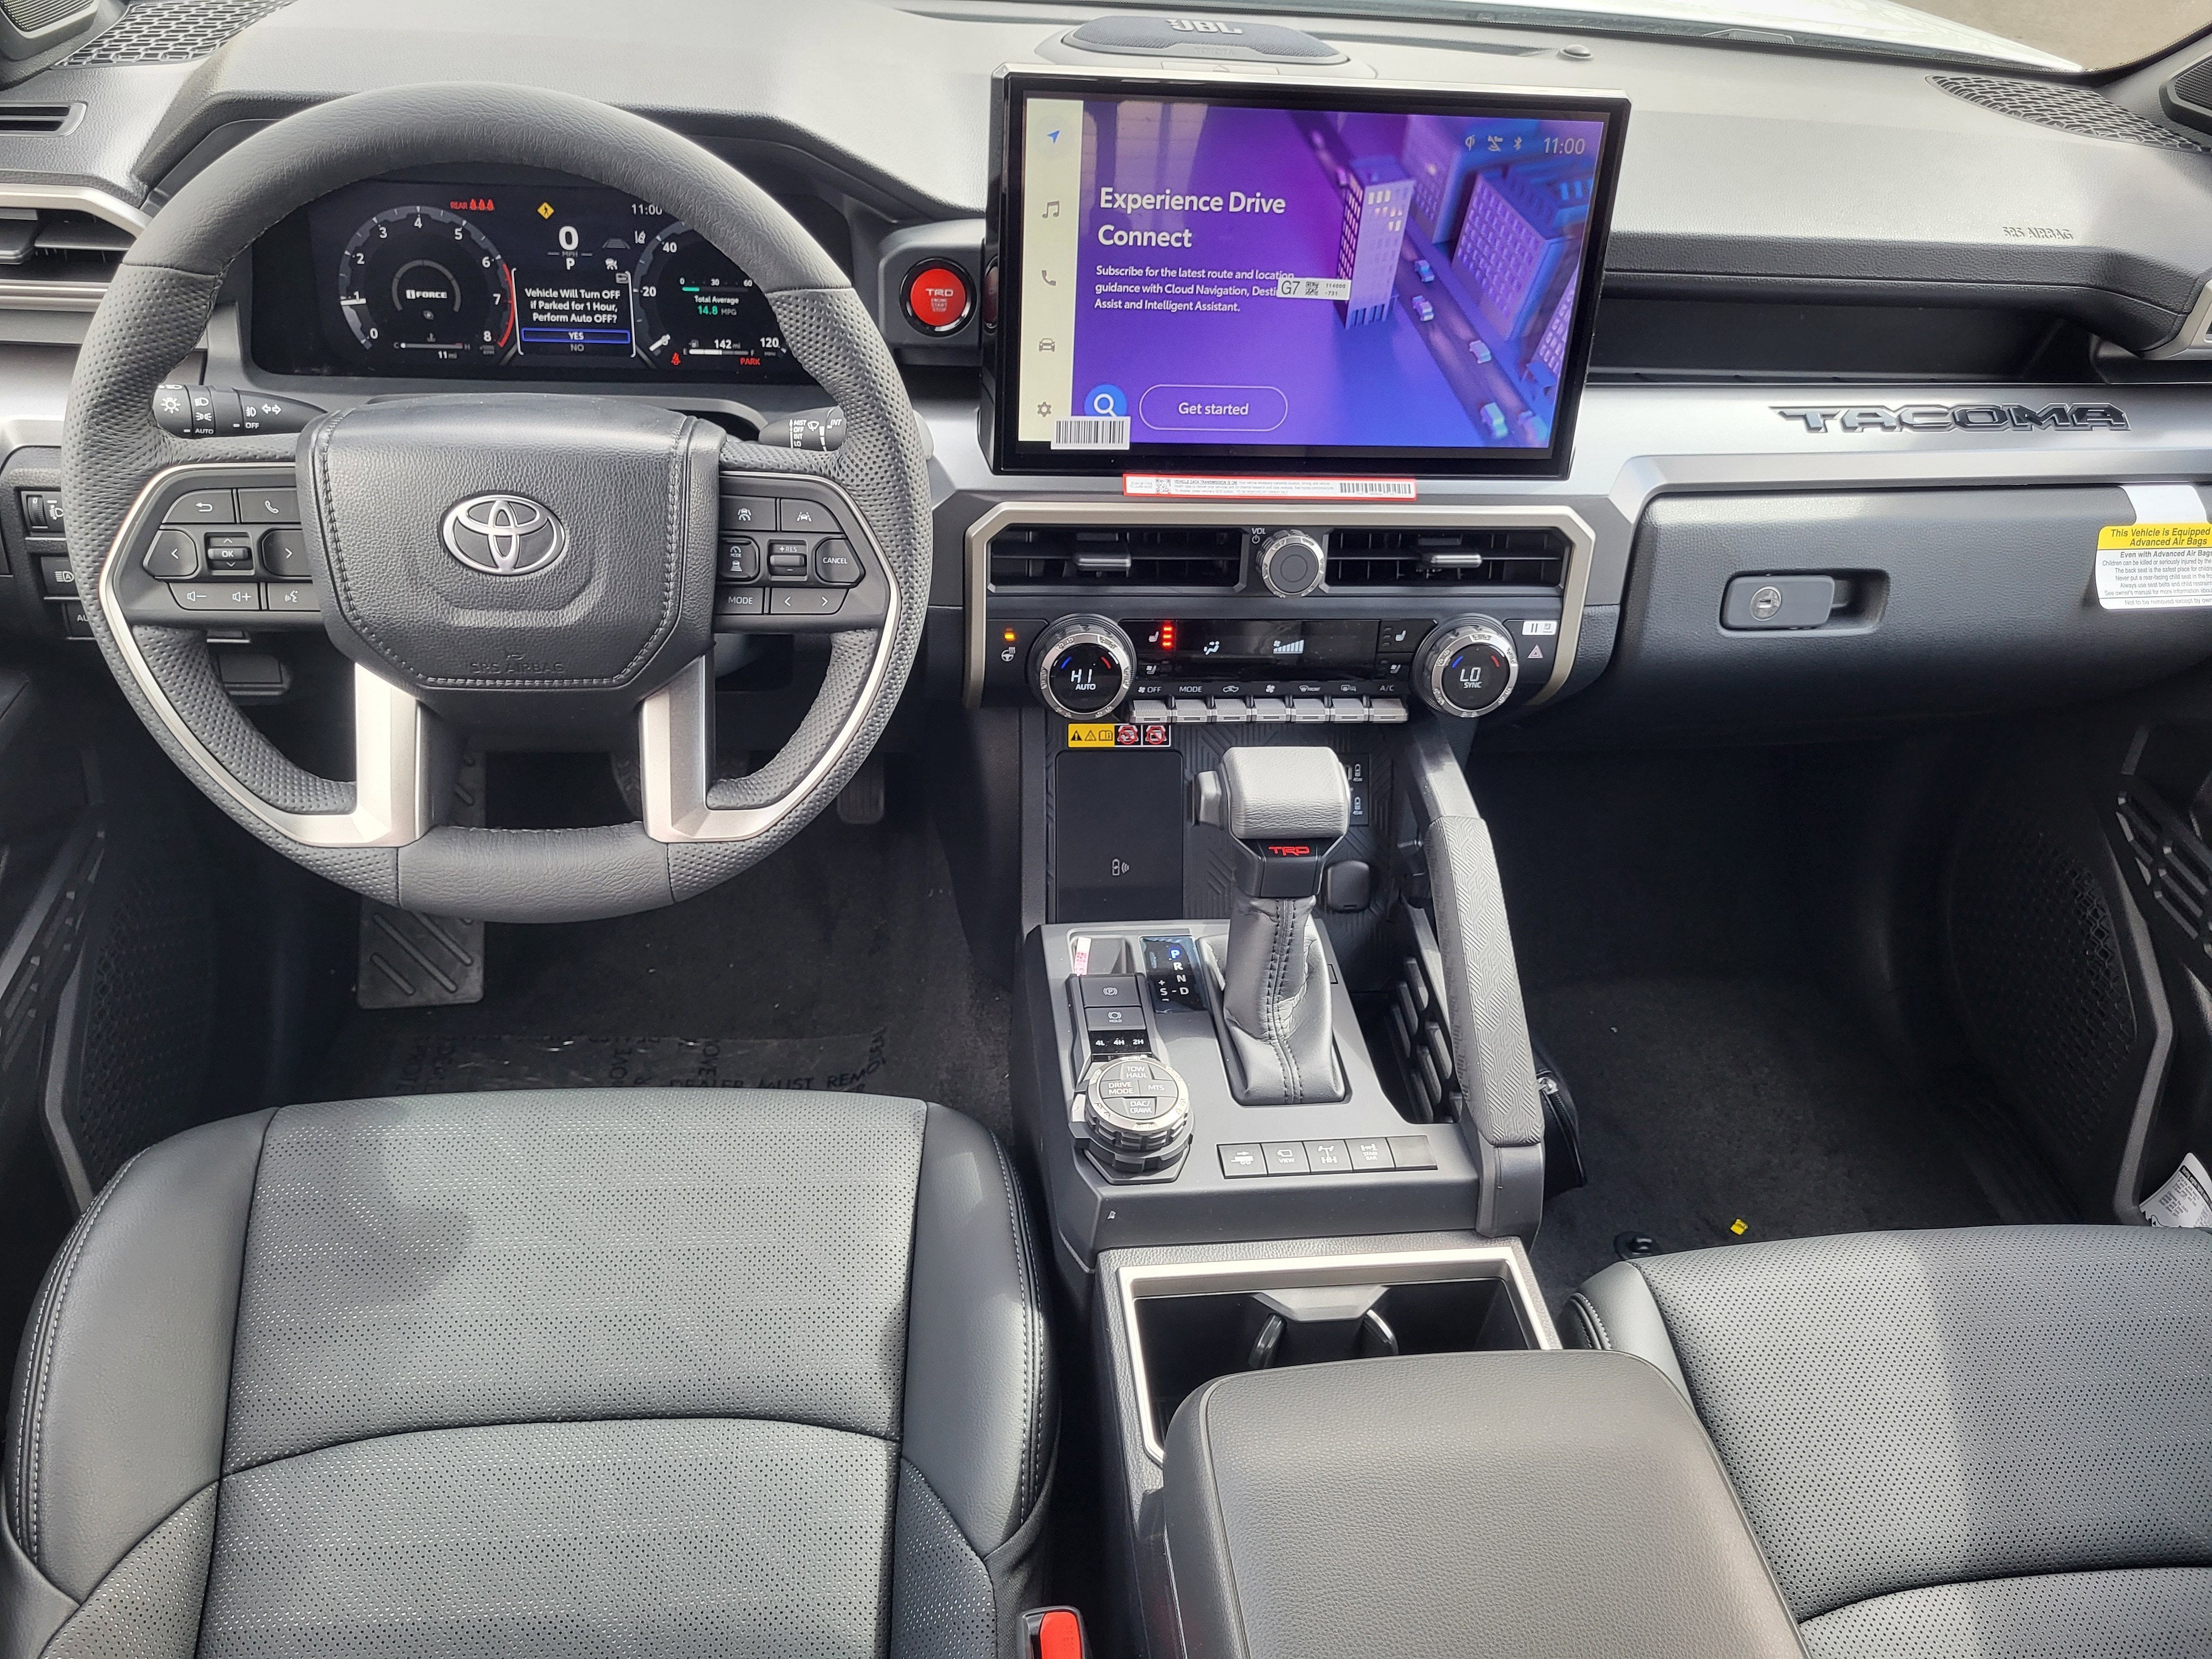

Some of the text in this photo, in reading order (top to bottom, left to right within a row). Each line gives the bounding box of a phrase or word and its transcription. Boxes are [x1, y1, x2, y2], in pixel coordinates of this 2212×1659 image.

[1168, 19, 1243, 35] JBL
[1543, 137, 1585, 155] 11:00
[1099, 187, 1286, 214] Experience Drive
[632, 204, 662, 215] 11:00
[414, 217, 422, 228] 4
[379, 227, 388, 238] 3
[455, 229, 462, 240] 5
[1098, 224, 1193, 248] Connect
[2002, 227, 2073, 239] SRS AIRBAG
[559, 226, 579, 251] 0
[663, 242, 677, 253] 40
[357, 253, 365, 264] 2
[482, 257, 491, 268] 6
[566, 258, 575, 270] P
[1096, 265, 1294, 280] Subscribe for the latest route and location
[642, 286, 656, 297] 20
[926, 288, 954, 297] TRD
[1095, 283, 1277, 297] guidance with Cloud Navigation, Desti
[1281, 280, 1300, 295] G7
[524, 288, 620, 299] Vehicle Will Turn OFF
[493, 294, 501, 305] 7
[712, 295, 739, 305] Average
[530, 300, 618, 312] If Parked for 1 Hour,
[697, 305, 718, 315] 14.8
[1094, 299, 1240, 312] Assist and Intelligent Assistant.
[533, 312, 617, 323] Perform Auto OFF?
[369, 328, 378, 339] 0
[483, 331, 492, 342] 8
[568, 332, 584, 340] YES
[714, 340, 732, 349] 142
[760, 337, 779, 347] 120
[438, 351, 447, 359] 11
[1178, 402, 1249, 415] Get started
[1768, 403, 2131, 432] TACOMA
[2131, 528, 2160, 536] Vehicle
[2162, 528, 2169, 536] is
[2172, 528, 2210, 539] Equipped
[2130, 538, 2171, 546] Advanced
[2187, 537, 2207, 546] Bags
[728, 596, 753, 604] MODE
[472, 663, 565, 674] SRS AIRBAG
[1071, 669, 1093, 684] HI
[1460, 667, 1481, 682] LO
[1269, 845, 1310, 856] TRD
[1171, 950, 1180, 958] P
[1173, 962, 1183, 971] R
